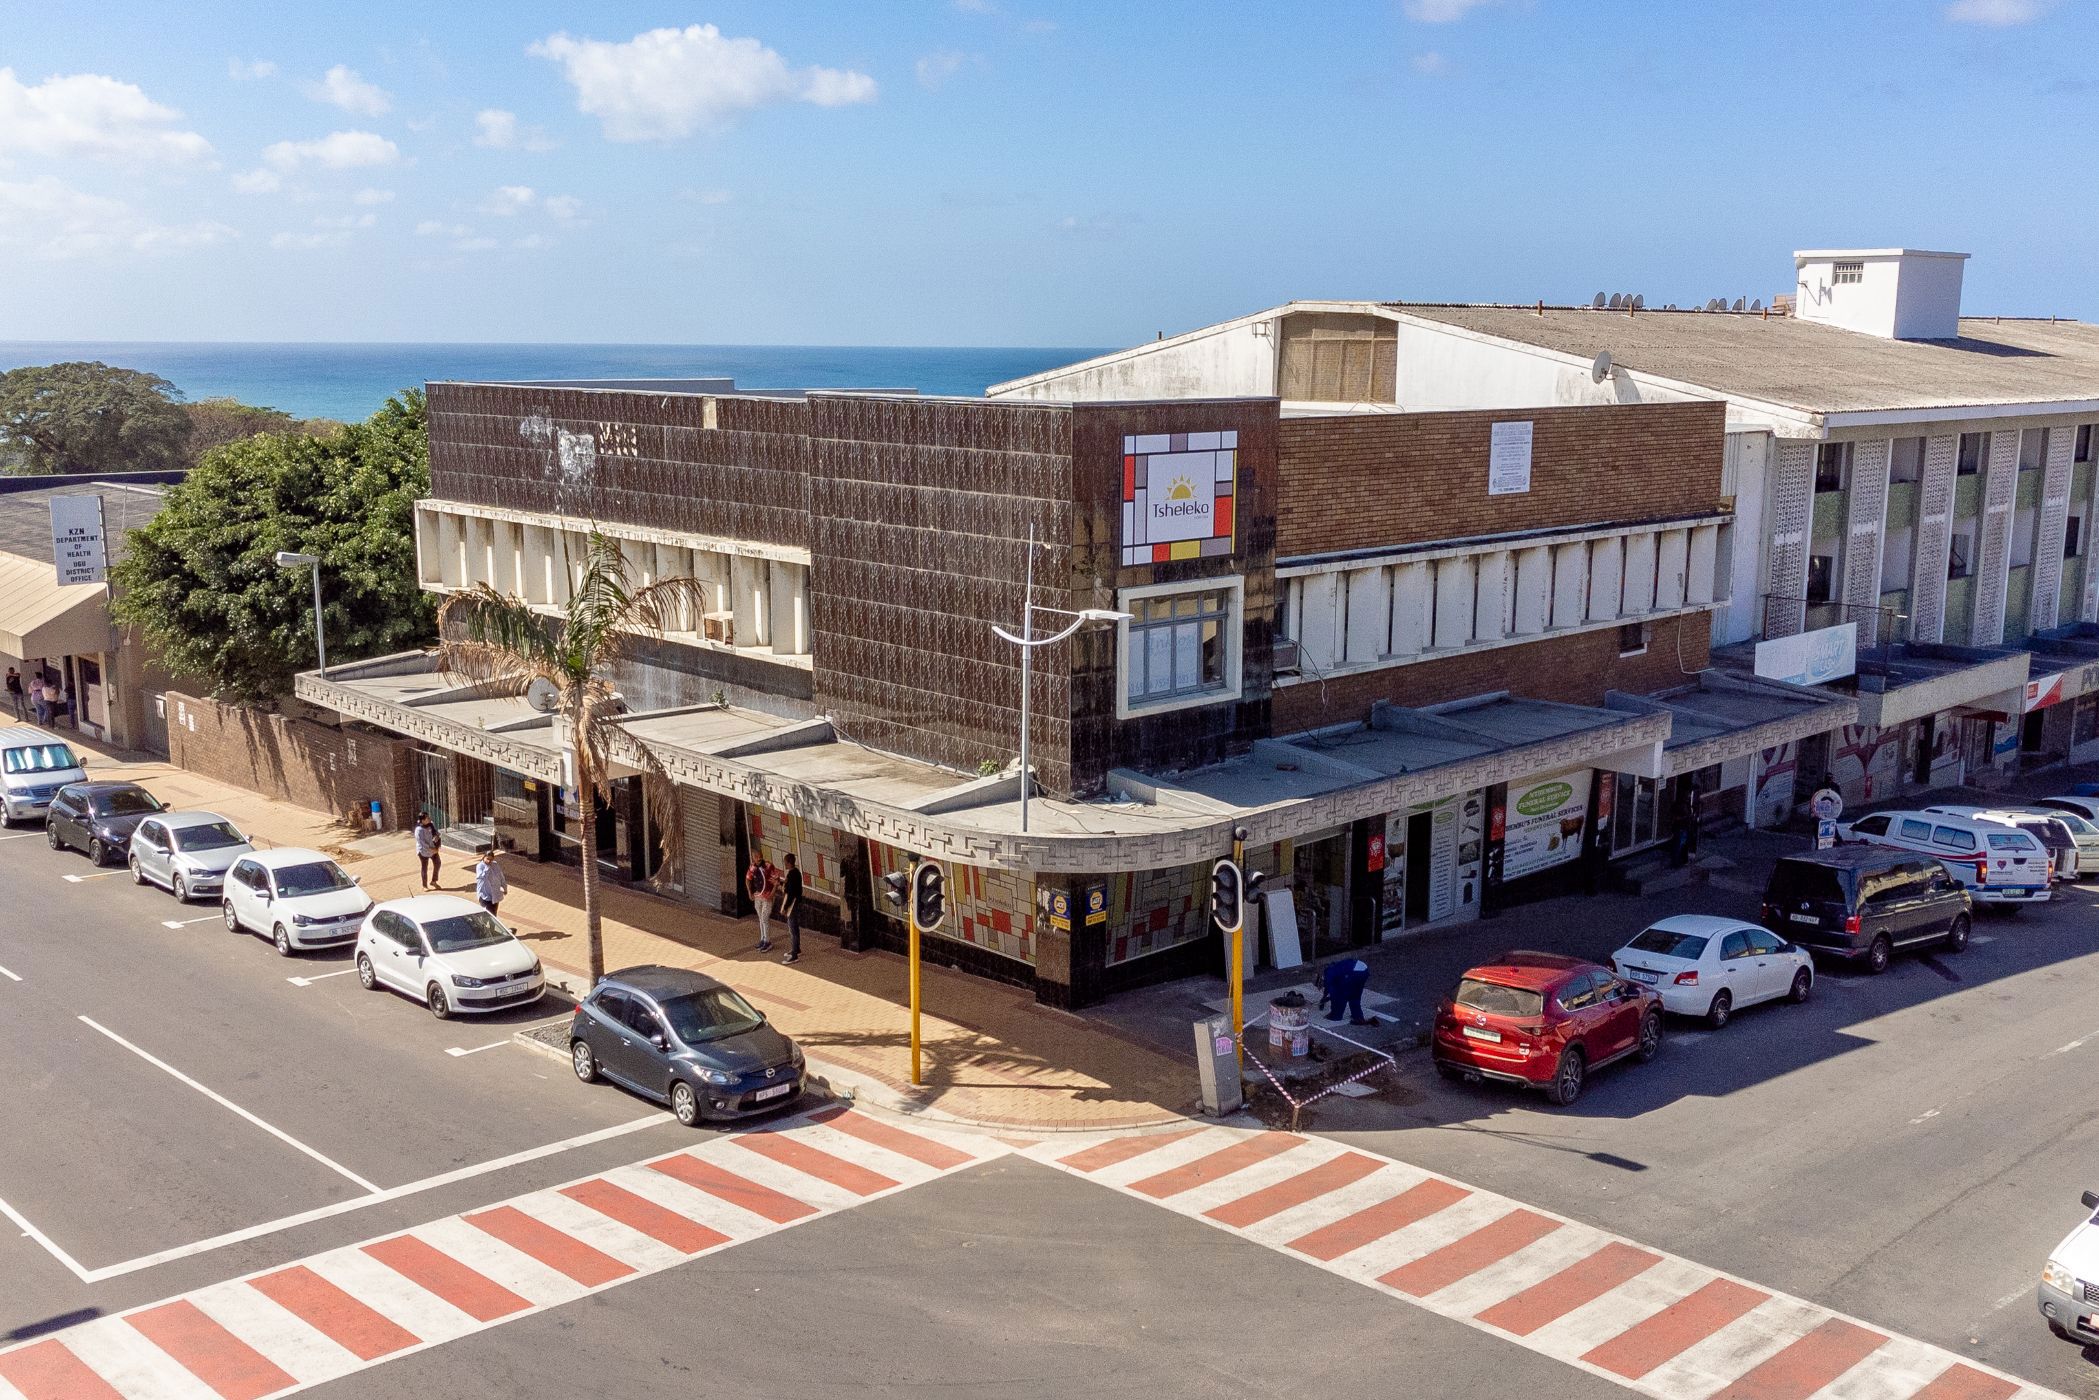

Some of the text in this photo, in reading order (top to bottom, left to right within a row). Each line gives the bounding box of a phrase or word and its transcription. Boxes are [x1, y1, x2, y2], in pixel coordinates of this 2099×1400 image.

[1153, 501, 1209, 518] Tsheleko
[68, 528, 85, 536] KZN
[56, 535, 98, 543] DEPARTMENT
[66, 567, 95, 575] DISTRICT
[1531, 813, 1556, 826] FUNERAL
[1557, 804, 1583, 817] SERVICES
